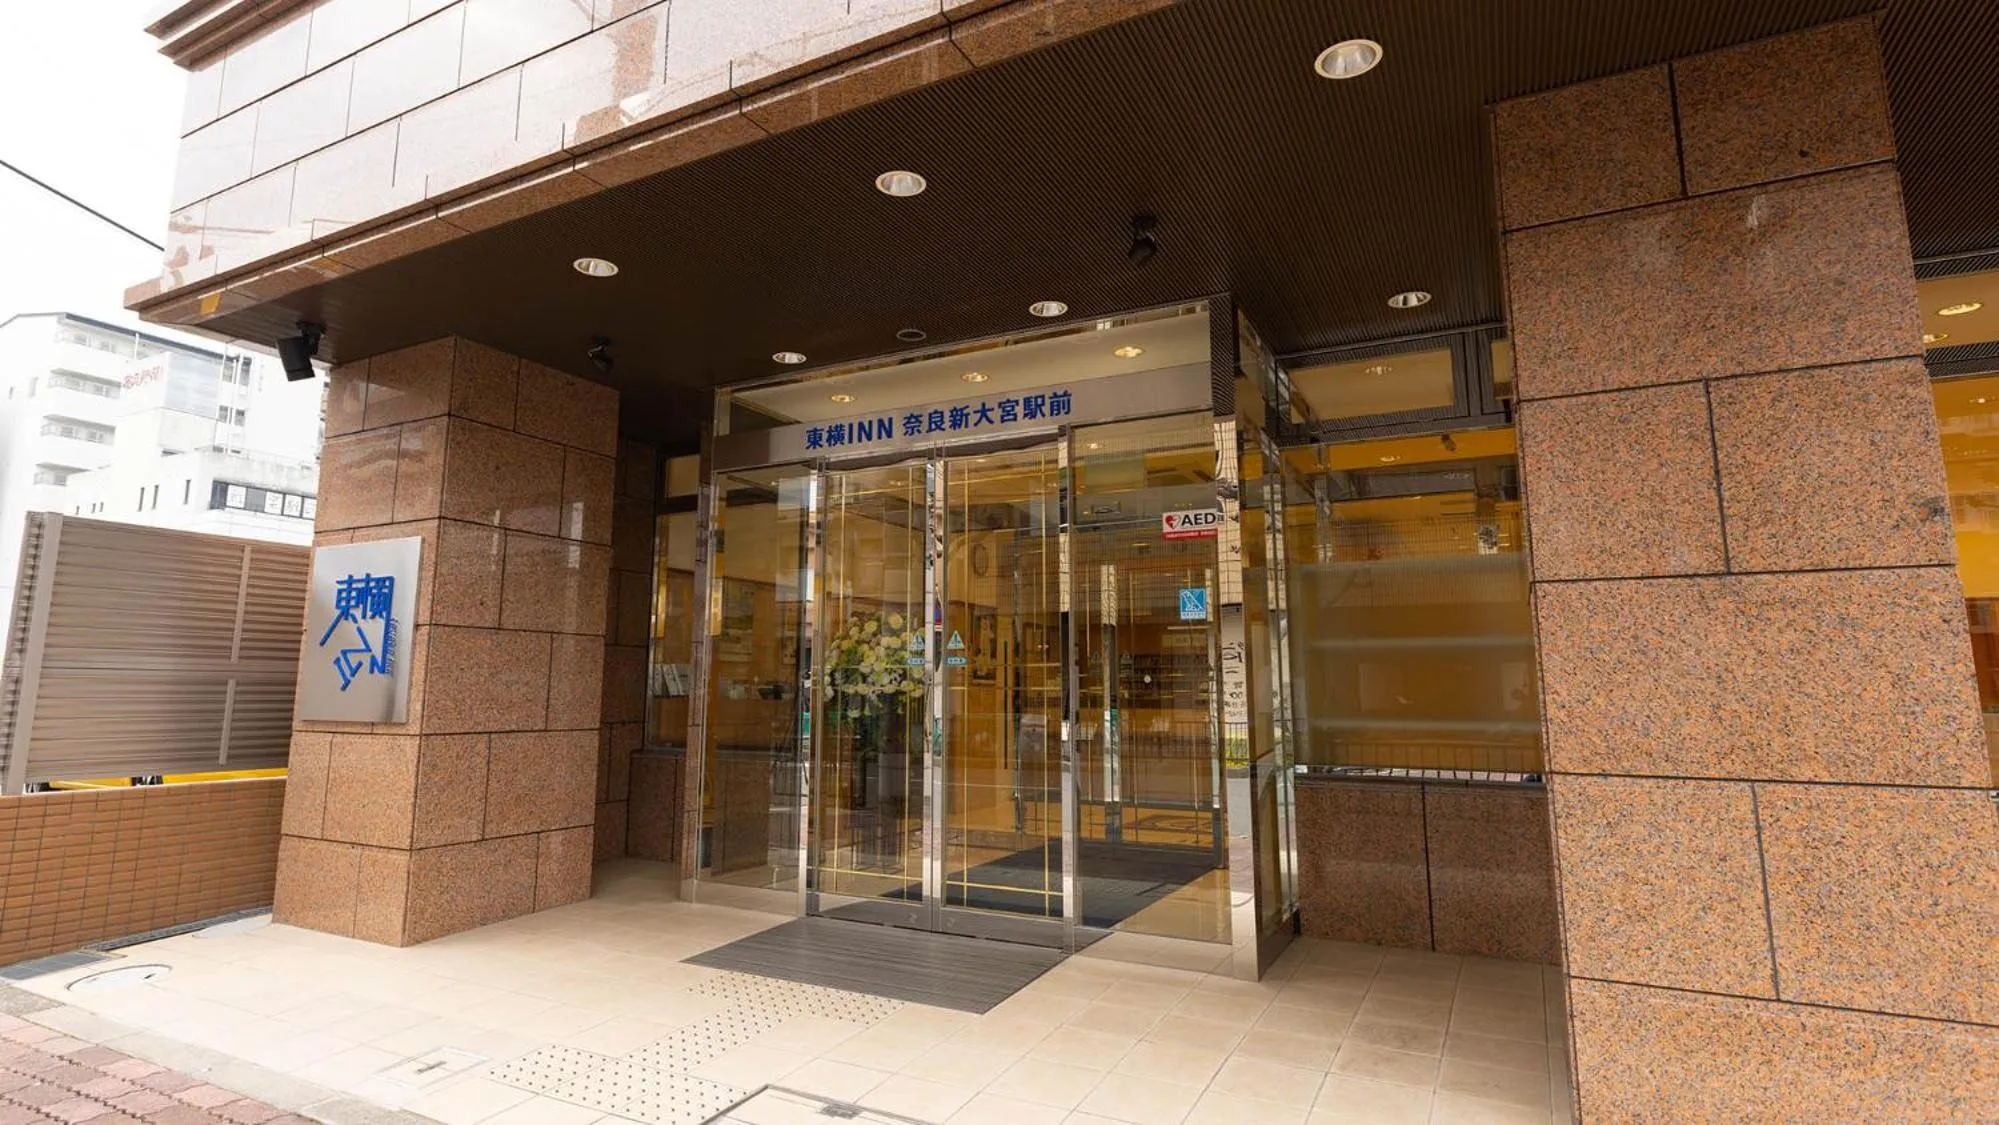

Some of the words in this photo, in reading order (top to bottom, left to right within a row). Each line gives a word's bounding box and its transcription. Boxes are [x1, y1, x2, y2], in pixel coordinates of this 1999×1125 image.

[805, 416, 894, 450] 東横INN
[902, 390, 1073, 436] 奈良新大宮駅前
[1181, 512, 1217, 526] AED
